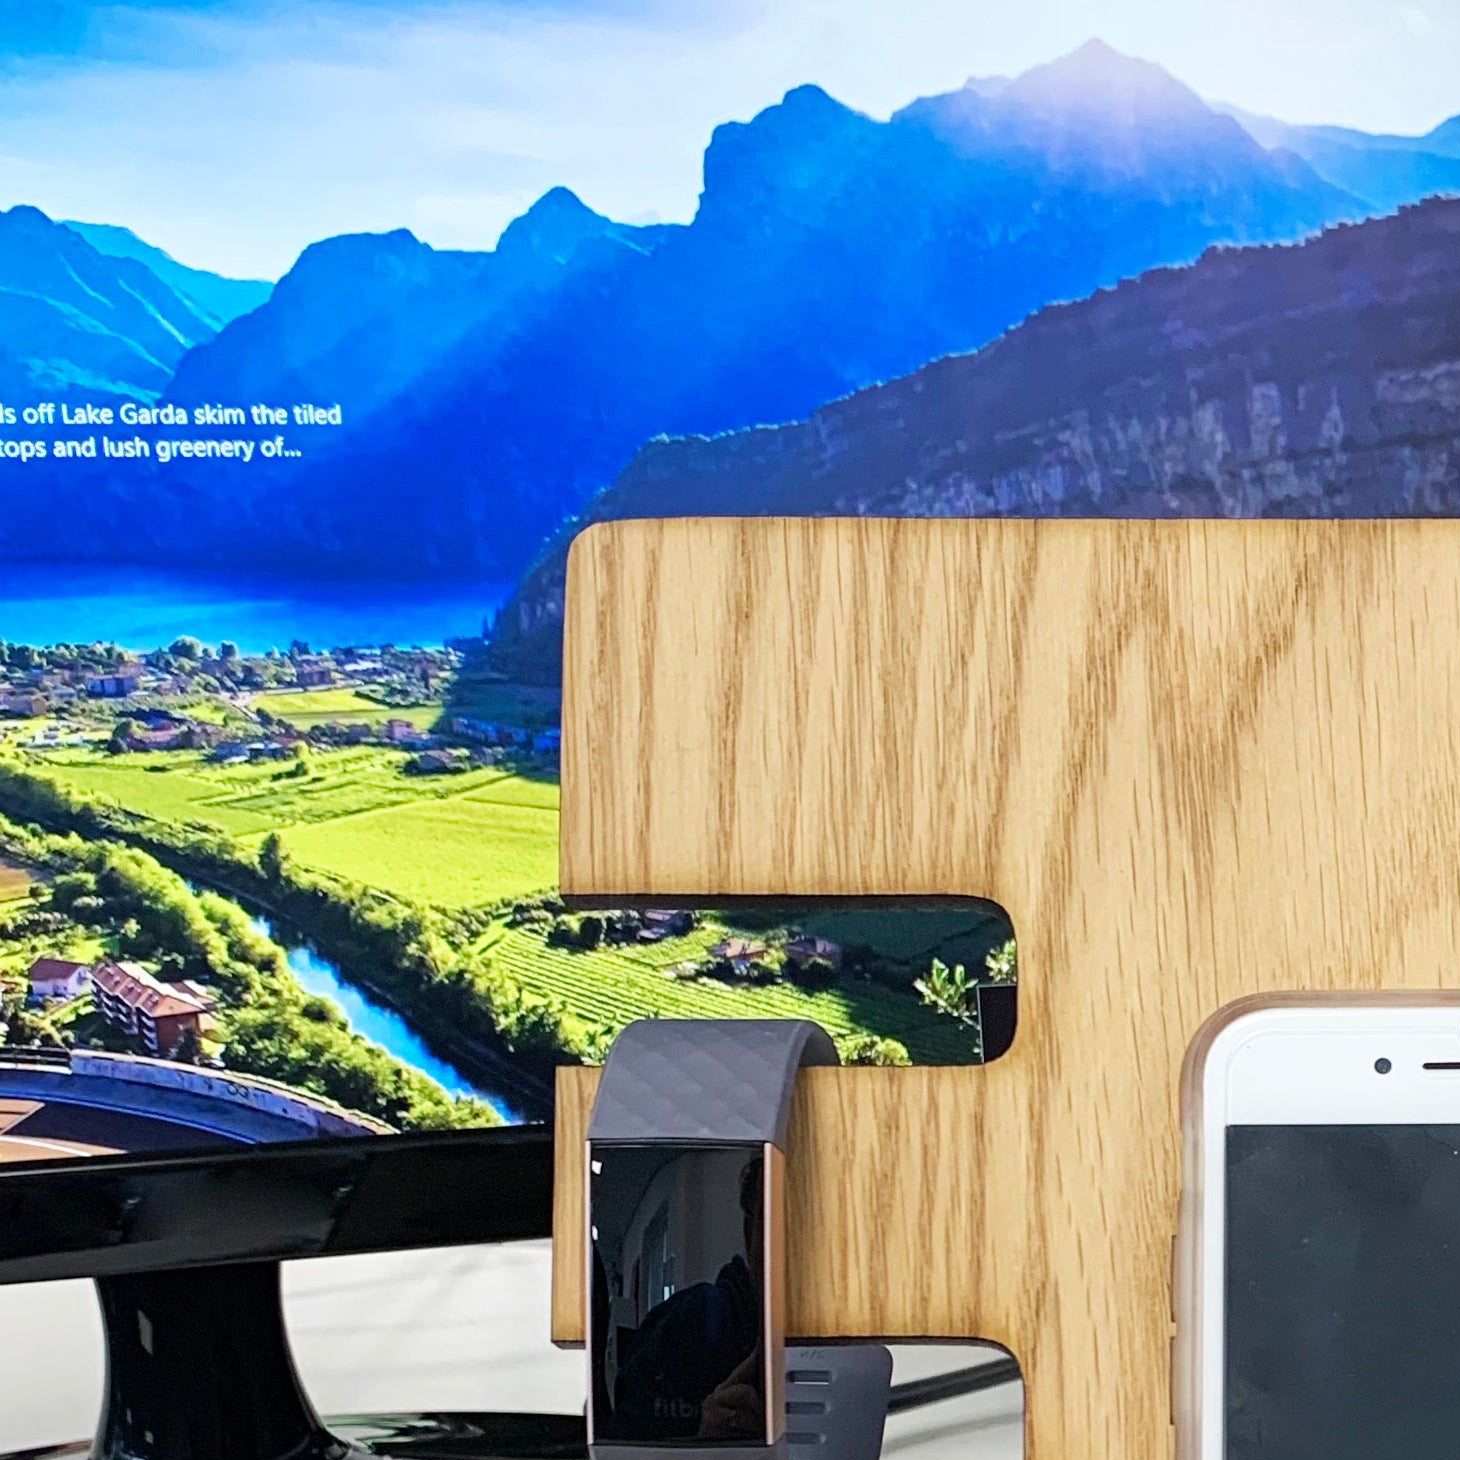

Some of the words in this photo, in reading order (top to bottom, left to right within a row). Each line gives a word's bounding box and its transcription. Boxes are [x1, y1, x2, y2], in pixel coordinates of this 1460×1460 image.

[22, 402, 56, 425] off
[61, 403, 114, 425] Lake
[119, 403, 188, 425] Garda
[193, 403, 246, 425] skim
[251, 403, 288, 425] the
[292, 403, 342, 425] tiled
[53, 436, 97, 458] and
[103, 436, 150, 458] lush
[155, 439, 255, 463] greenery
[260, 436, 302, 458] of...
